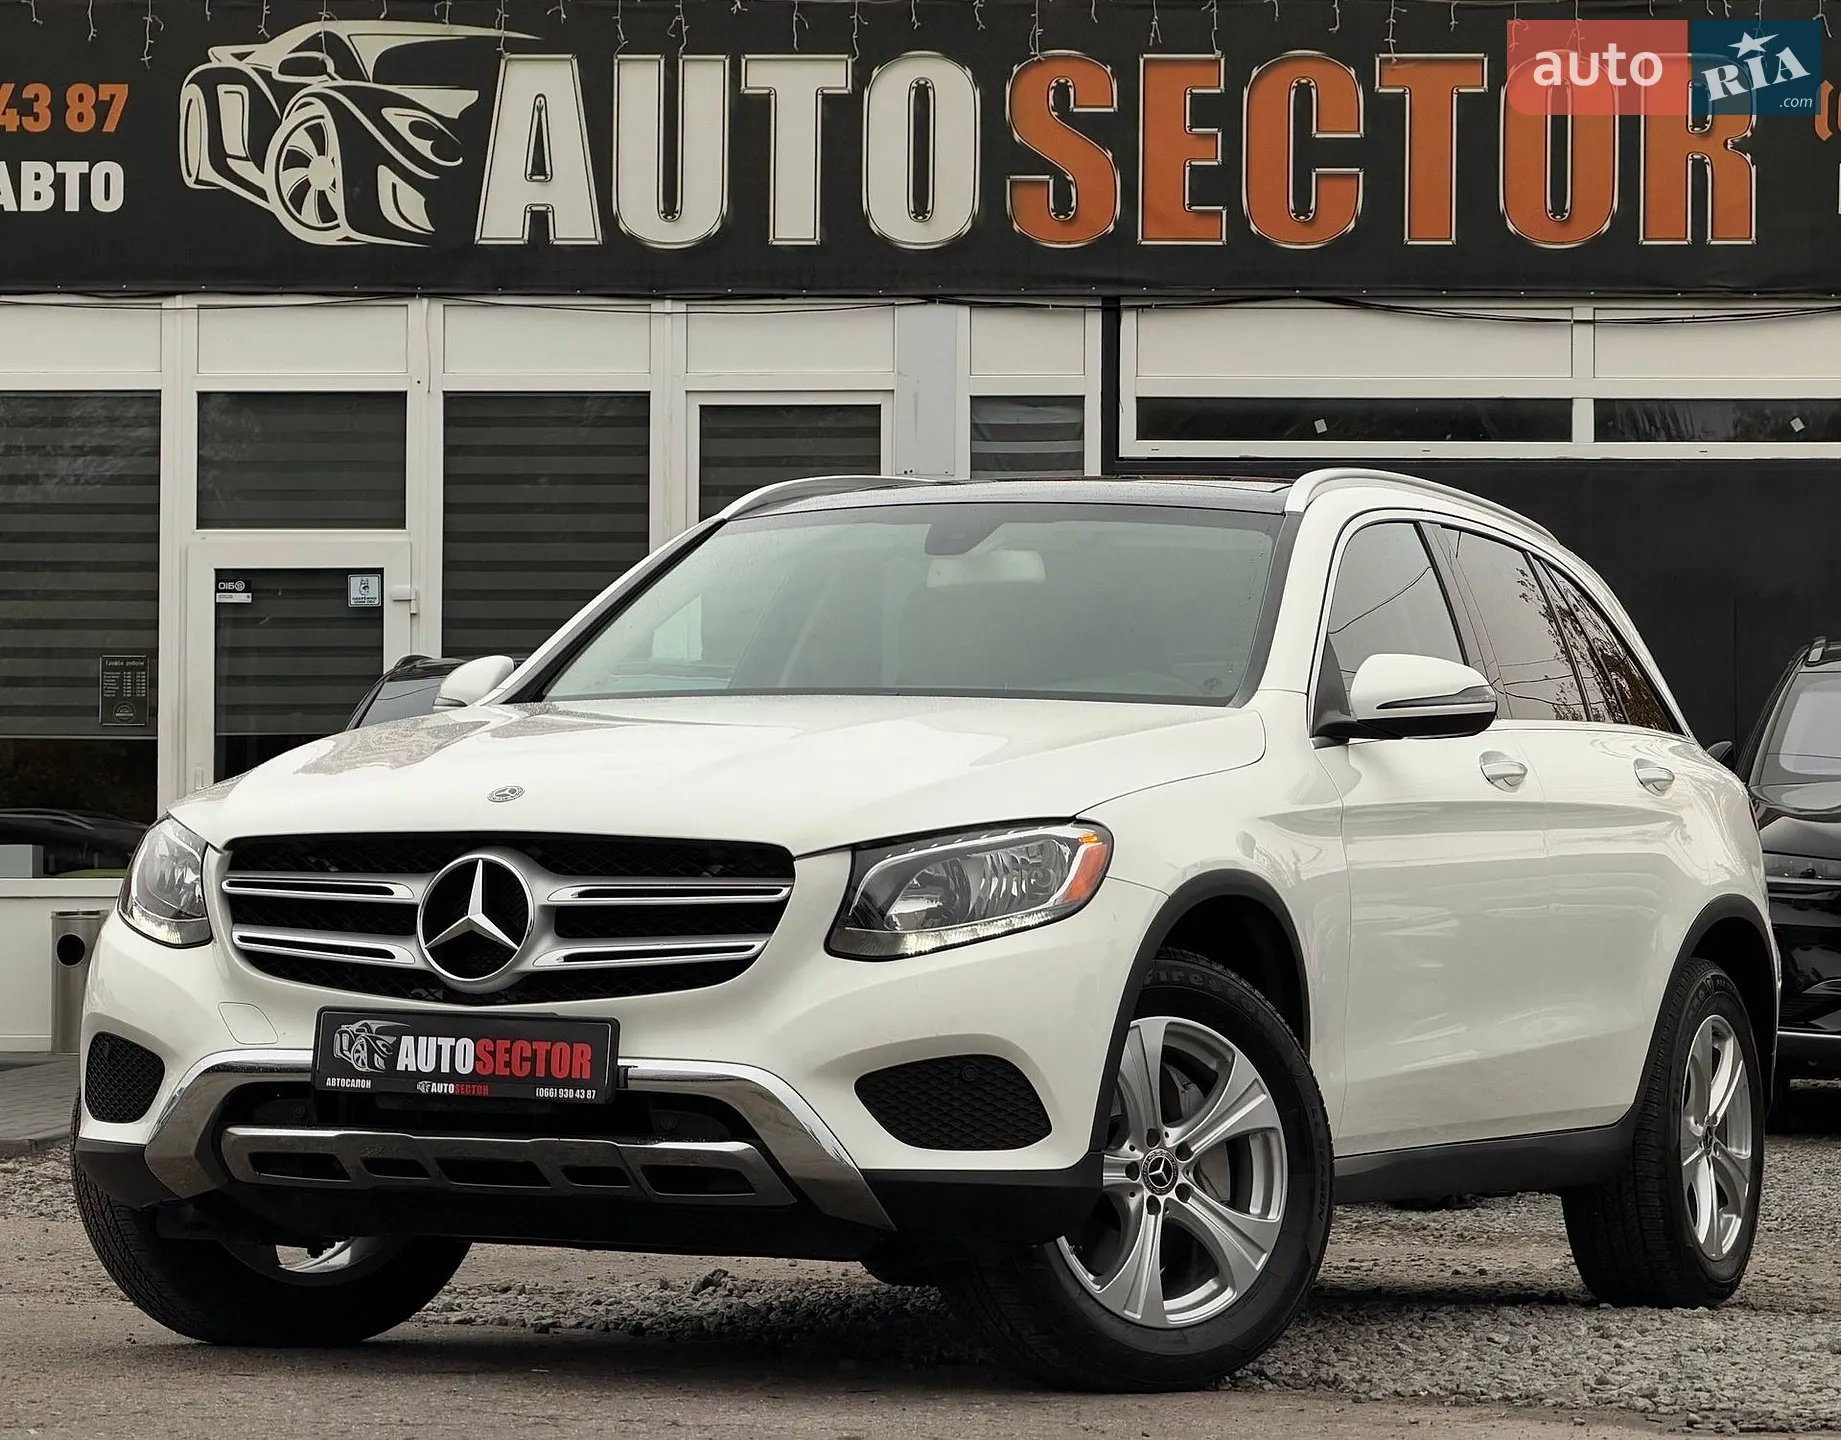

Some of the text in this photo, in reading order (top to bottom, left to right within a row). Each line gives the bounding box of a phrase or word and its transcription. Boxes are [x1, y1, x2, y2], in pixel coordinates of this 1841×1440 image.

[65, 82, 129, 133] 87
[474, 49, 1757, 249] AUTOSECTOR
[396, 1035, 592, 1080] AUTOSECTOR
[326, 1077, 372, 1089] АВТОСАЛОН
[431, 1082, 489, 1096] AUTOSECTOR
[536, 1087, 596, 1100] (066) 930 43 87
